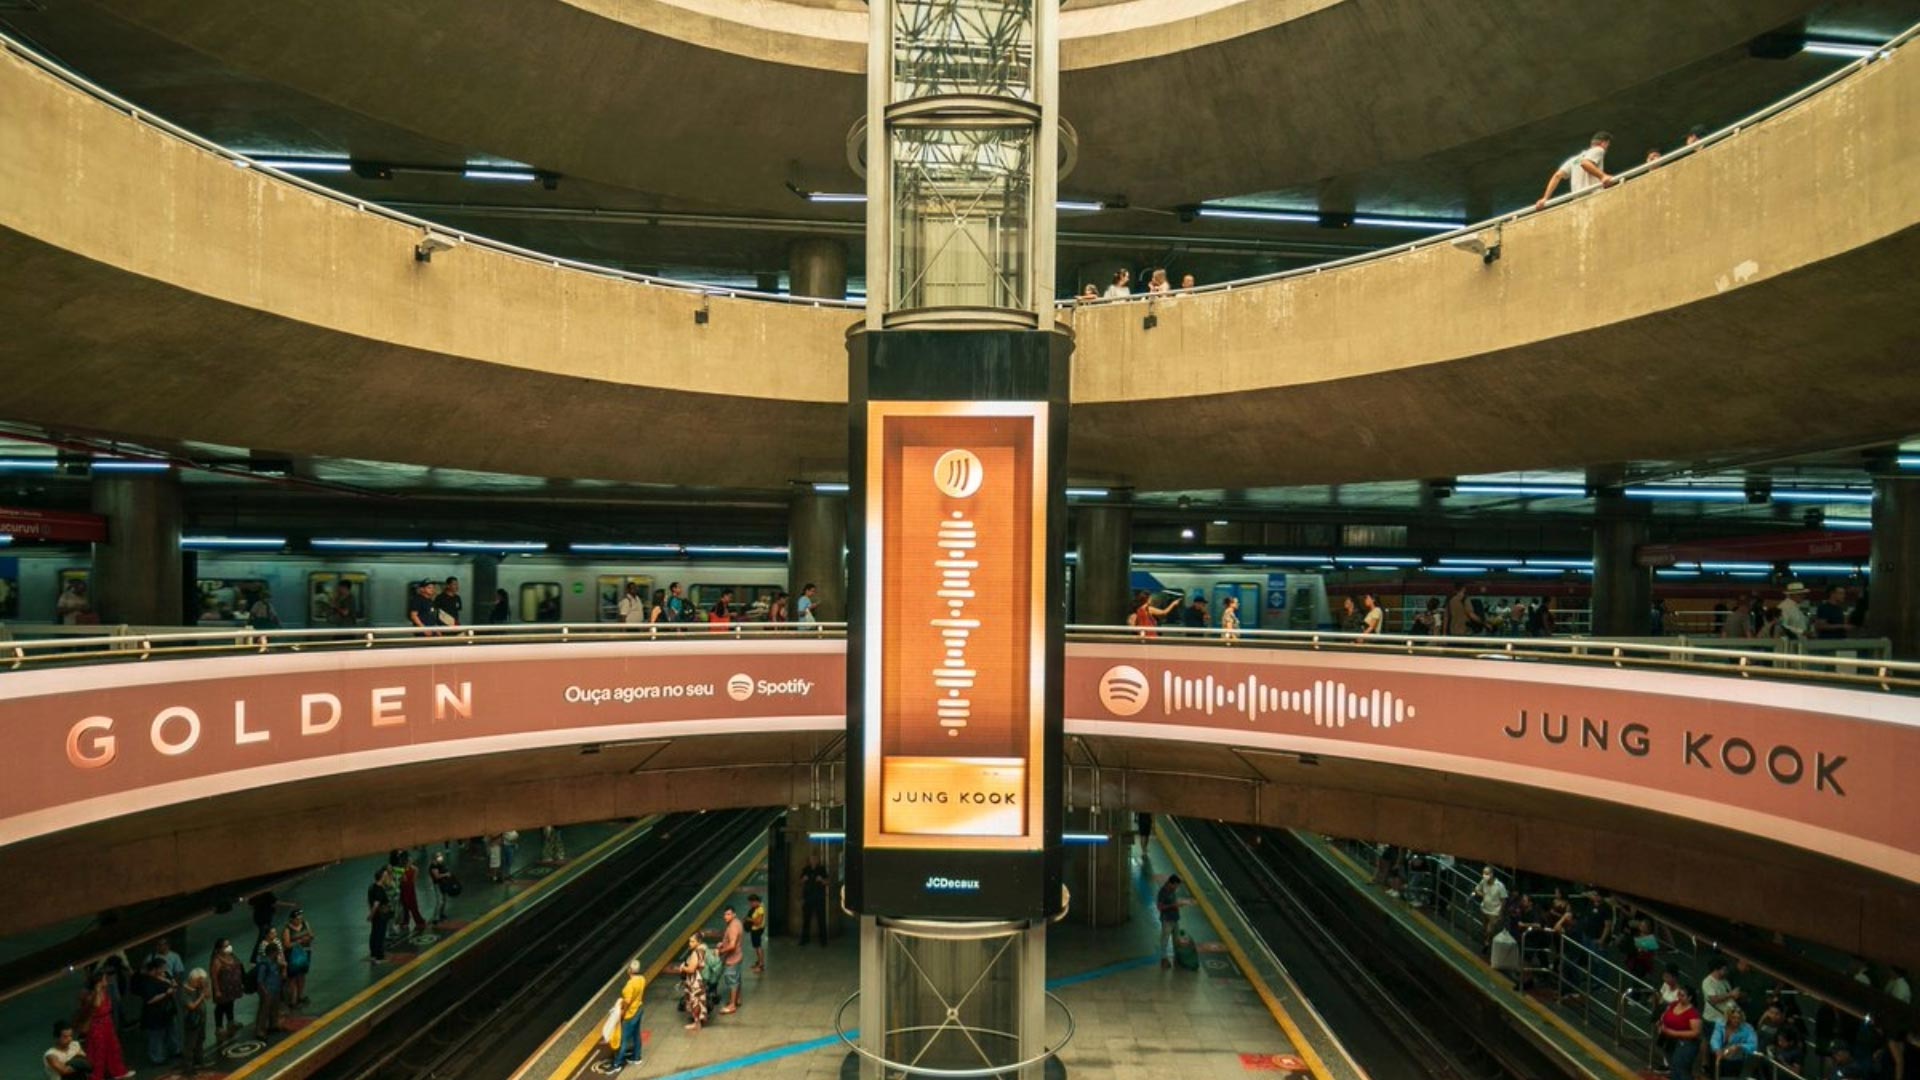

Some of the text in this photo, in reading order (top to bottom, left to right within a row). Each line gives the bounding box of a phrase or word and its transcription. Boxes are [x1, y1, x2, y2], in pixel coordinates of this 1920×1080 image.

[564, 678, 811, 706] Ouça agora no seu Spotify
[65, 681, 473, 770] GOLDEN
[1503, 709, 1848, 798] JUNG KOOK
[892, 791, 1016, 805] JUNG KOOK
[925, 876, 980, 889] JCDecaux
